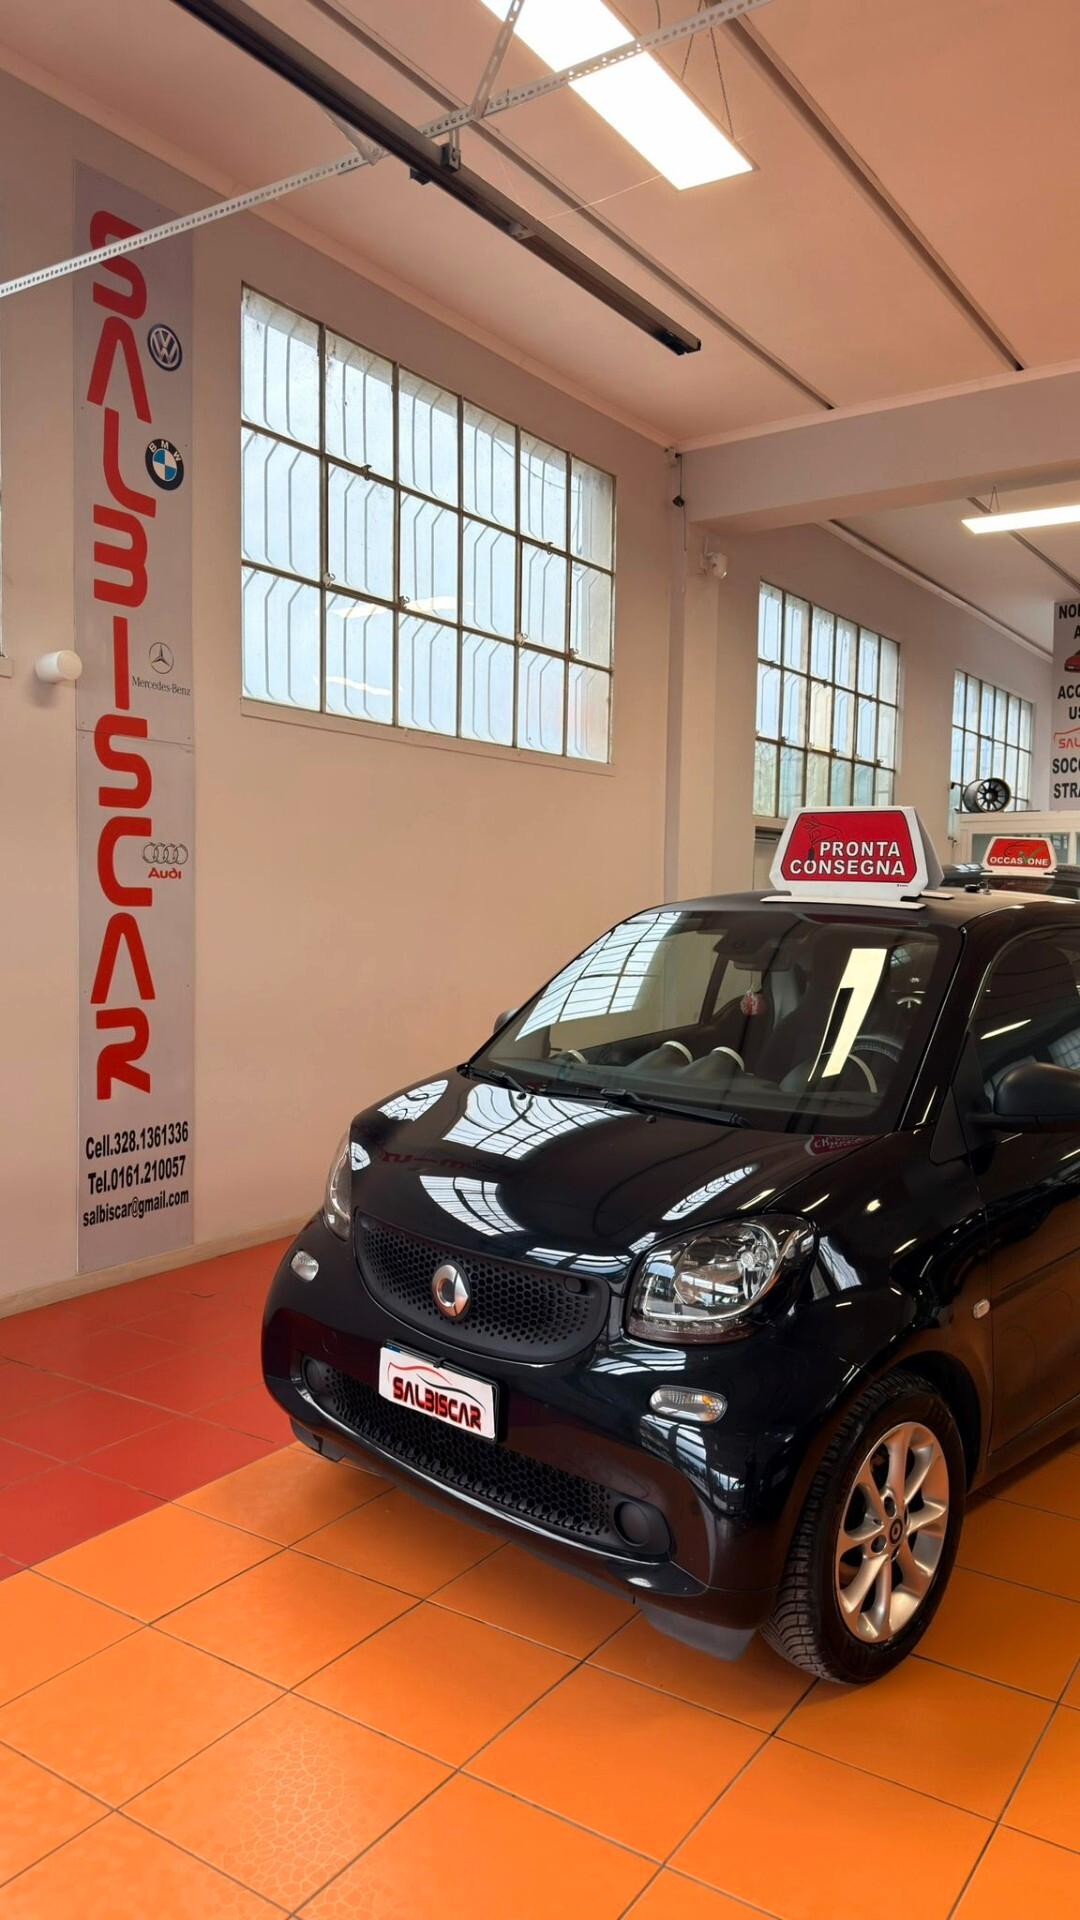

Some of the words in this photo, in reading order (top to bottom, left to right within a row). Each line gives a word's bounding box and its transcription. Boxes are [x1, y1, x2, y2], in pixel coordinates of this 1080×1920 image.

[149, 440, 182, 462] BMW
[1059, 604, 1080, 619] NO
[87, 210, 156, 1101] SALBISCAR
[132, 675, 191, 697] Mercedes-Benz
[820, 841, 900, 857] PRONTA
[148, 867, 182, 880] Audi
[790, 859, 906, 876] CONSEGNA
[86, 1120, 189, 1160] Cell.328.1361336
[88, 1155, 186, 1195] Tel.0161.210057
[83, 1189, 189, 1227] salbiscar@gmail.com
[393, 1376, 482, 1432] SALBISCAR
